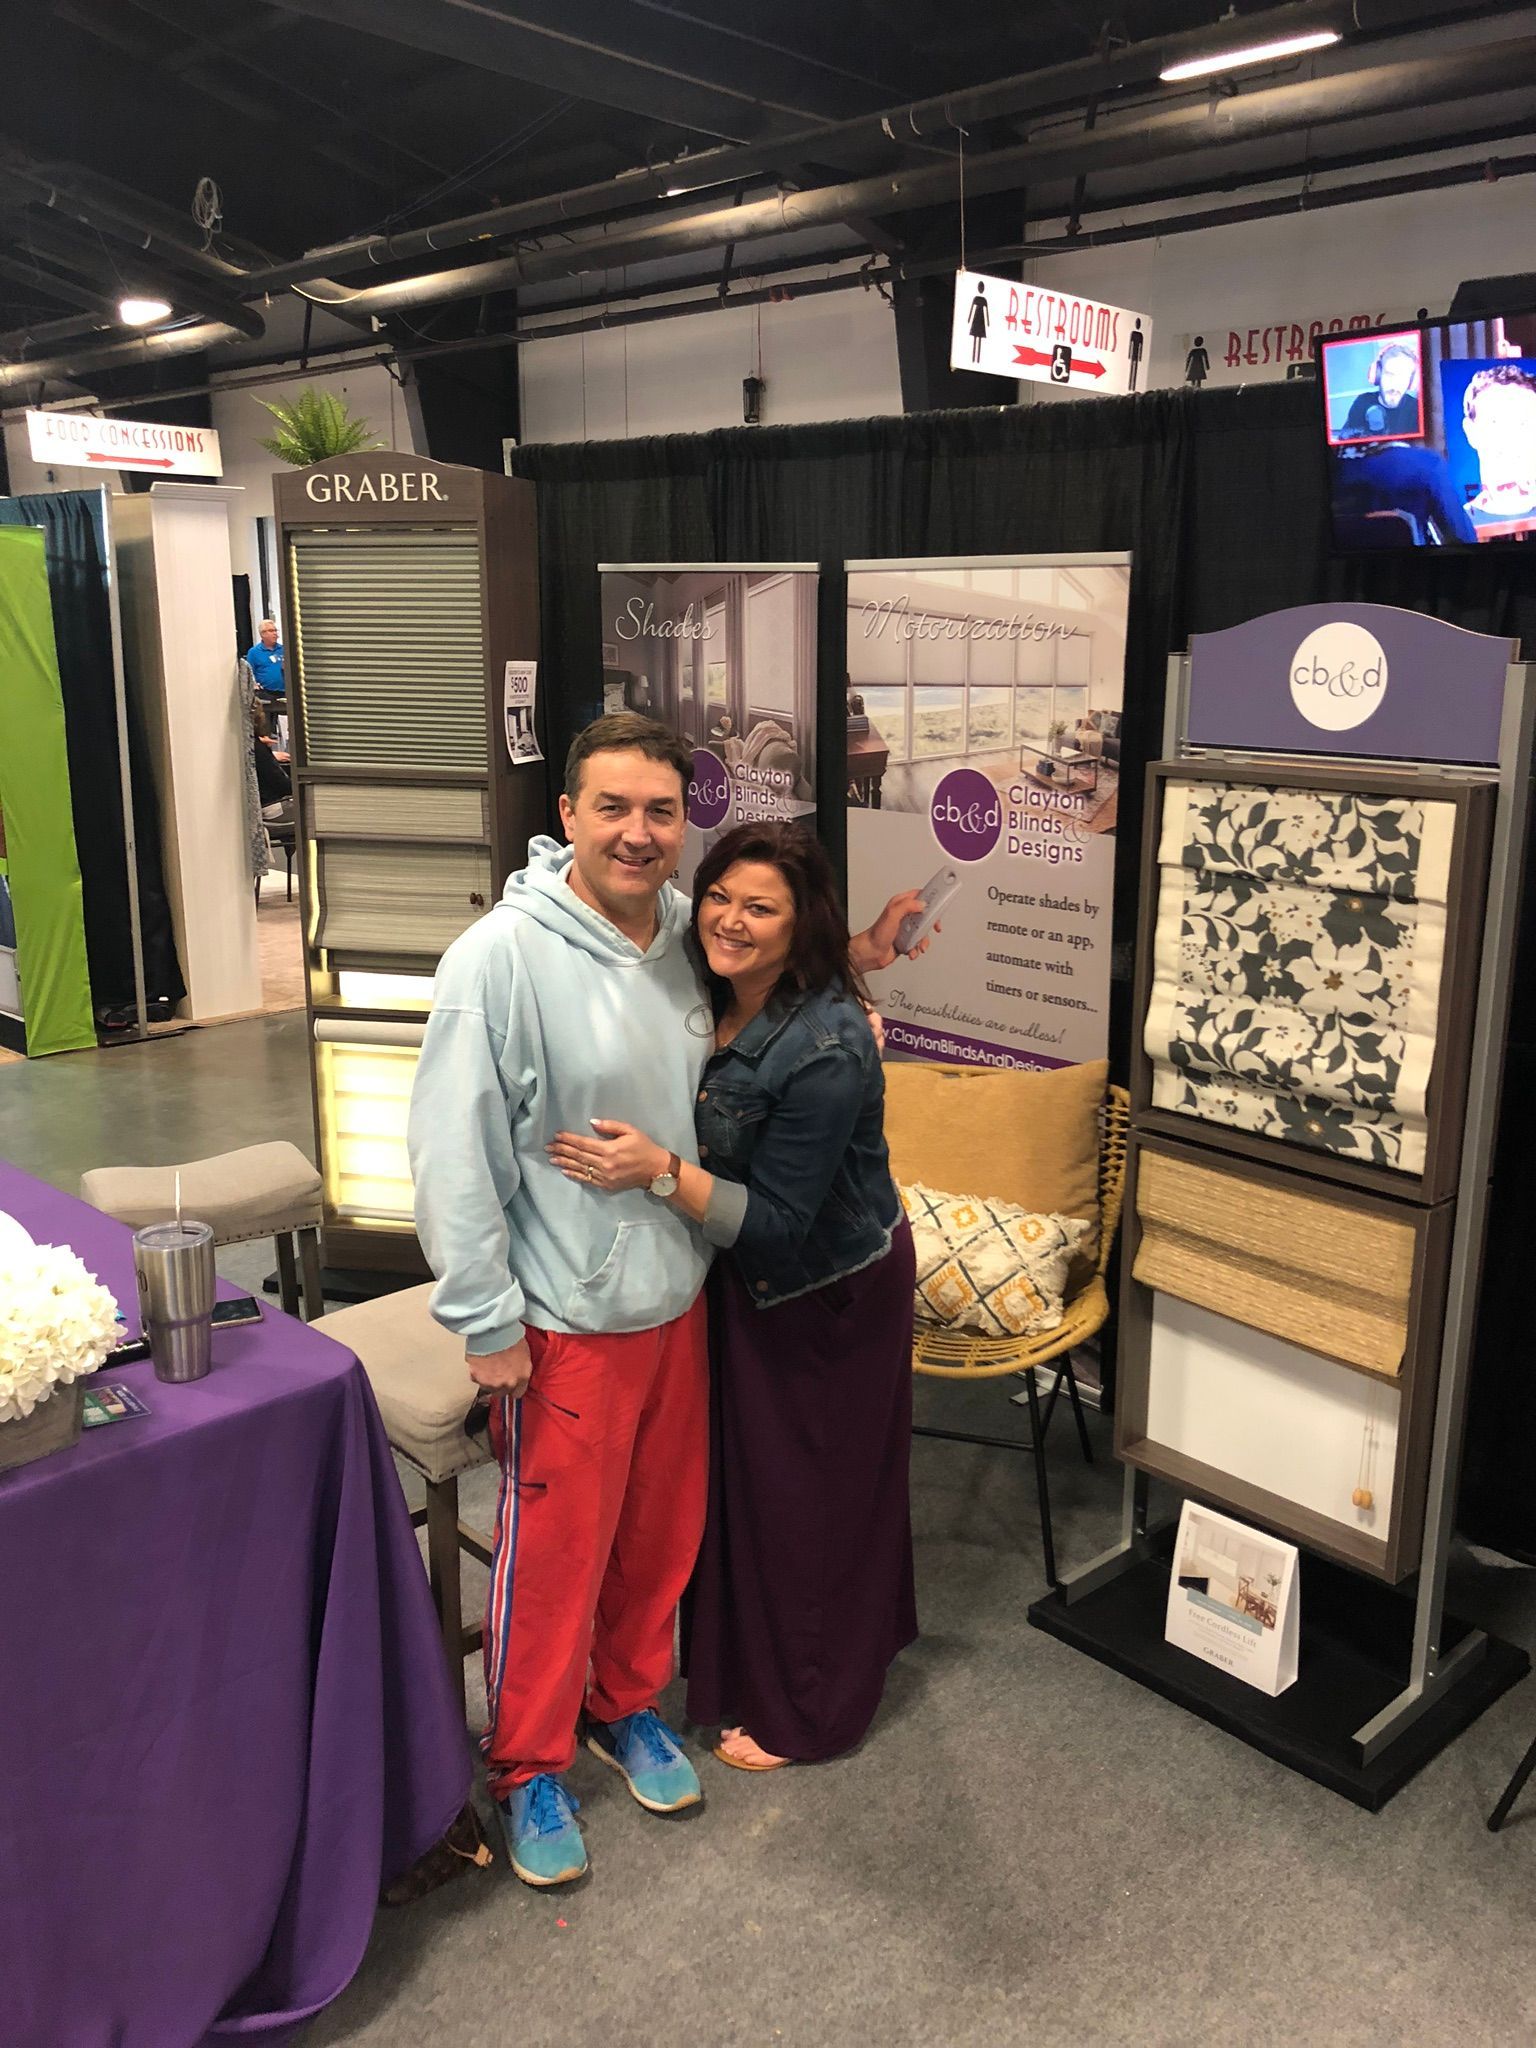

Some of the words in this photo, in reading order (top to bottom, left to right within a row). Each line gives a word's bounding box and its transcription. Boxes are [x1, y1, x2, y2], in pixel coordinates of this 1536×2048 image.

[1005, 287, 1120, 352] RESTROOMS
[46, 418, 90, 442] FOOD
[100, 425, 204, 453] CONCESSIONS
[615, 597, 718, 640] Shades
[861, 593, 1078, 644] Motorization
[511, 676, 528, 693] $500
[1293, 655, 1382, 697] cb&d
[735, 764, 792, 786] Clayton
[735, 786, 776, 806] Blinds
[1009, 785, 1085, 811] Clayton
[933, 795, 999, 834] cb&d
[1009, 811, 1062, 834] Blinds
[1008, 836, 1083, 864] Designs
[987, 886, 1036, 906] Operate
[1039, 893, 1080, 913] shades
[1084, 899, 1100, 919] by
[986, 921, 1028, 936] remote
[1031, 928, 1045, 939] or
[1048, 931, 1063, 942] an
[1067, 934, 1095, 951] app,
[986, 952, 1042, 970] automate
[1045, 961, 1073, 976] with
[986, 980, 1022, 998] timers
[1025, 990, 1039, 1001] or
[1042, 993, 1098, 1013] sensors...
[887, 989, 913, 1011] The
[913, 1002, 983, 1027] possibilities
[985, 1019, 1006, 1032] are
[1009, 1022, 1066, 1044] endless!
[1188, 1608, 1206, 1622] Free
[1207, 1618, 1241, 1640] Cordless
[1203, 1646, 1234, 1666] GRABER
